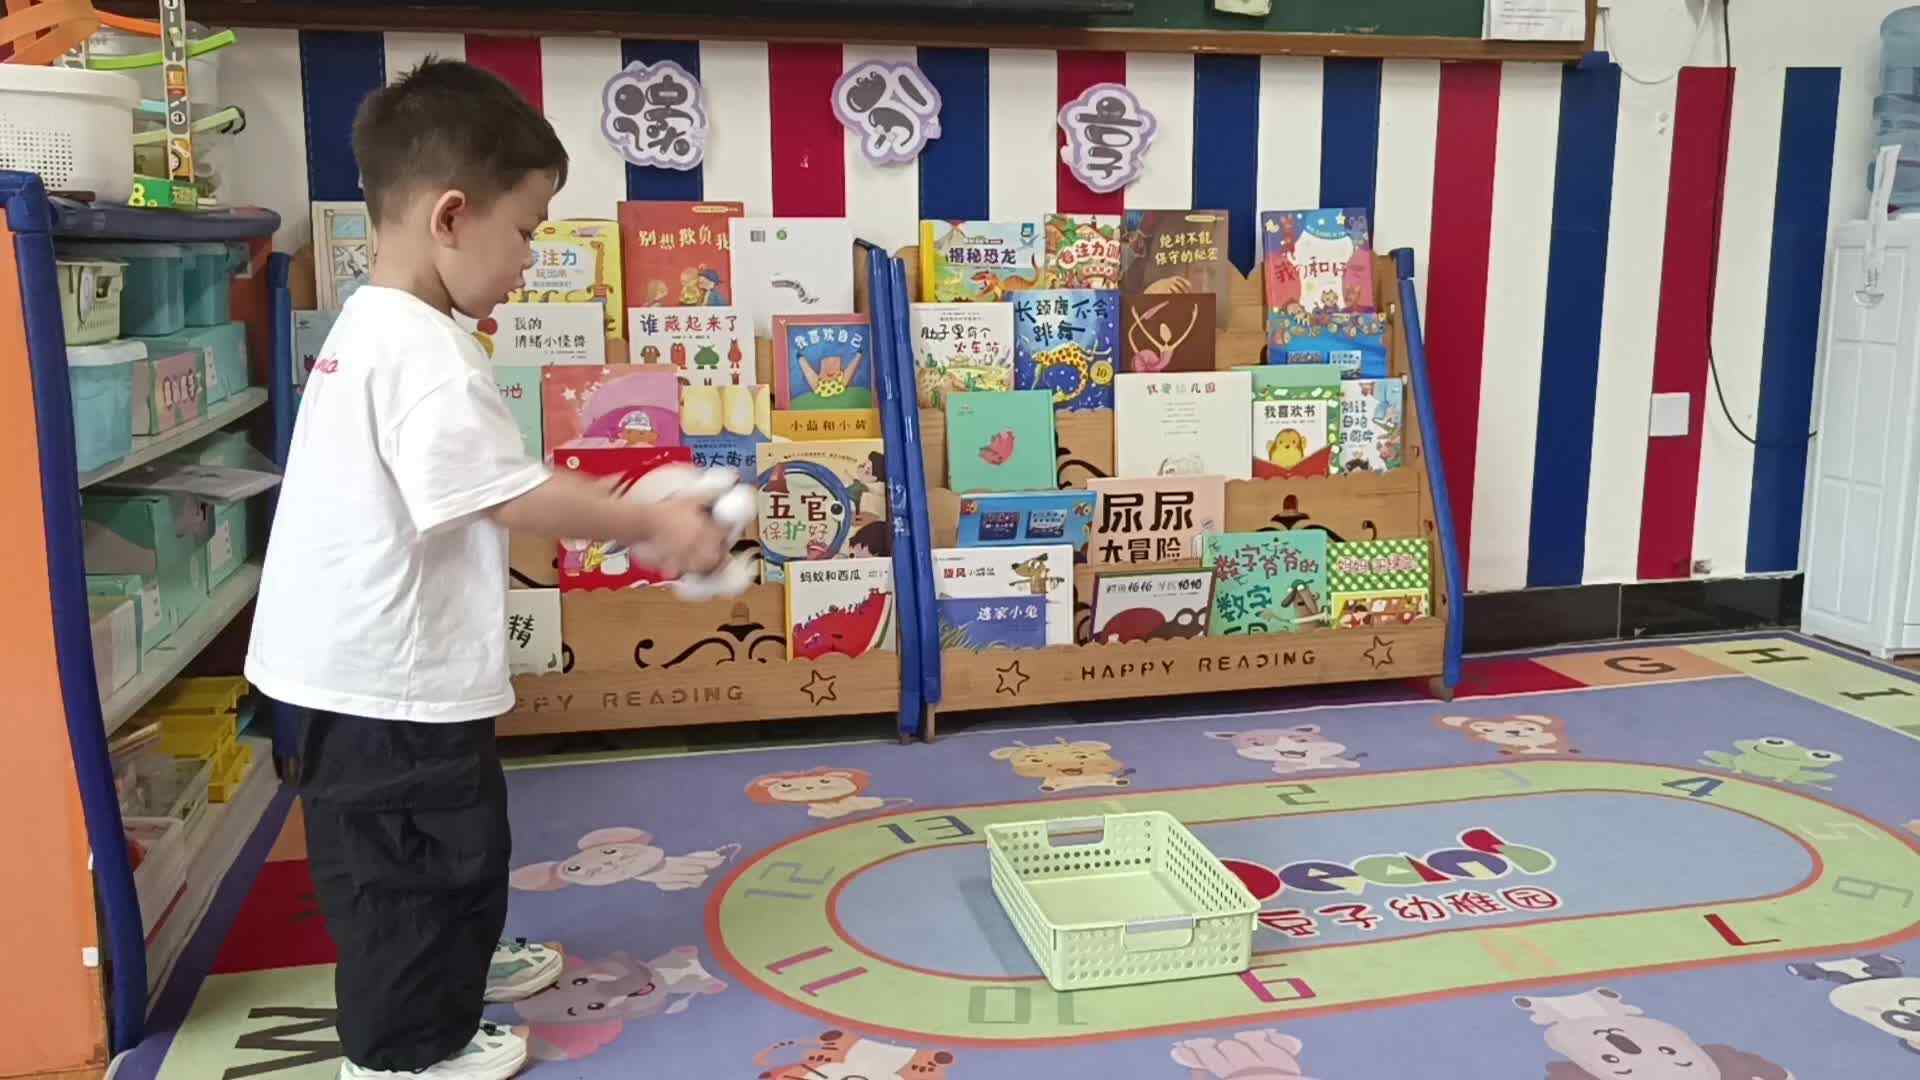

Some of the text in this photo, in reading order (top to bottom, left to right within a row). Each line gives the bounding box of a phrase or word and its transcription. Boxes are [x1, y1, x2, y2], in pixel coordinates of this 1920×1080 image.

[1160, 231, 1213, 248] 绝对不能
[949, 247, 1017, 265] 揭秘恐龙
[1154, 247, 1219, 265] 保守的秘密
[1016, 296, 1109, 324] 长颈鹿不会
[514, 316, 543, 331] 我的
[639, 313, 738, 337] 谁藏起来了
[920, 323, 991, 341] 肚子里有个
[1033, 319, 1086, 347] 跳舞
[514, 334, 586, 349] 情绪小怪兽
[794, 327, 864, 349] 我喜欢自己
[953, 341, 1000, 354] 火车站
[1264, 405, 1316, 418] 我喜欢书
[790, 419, 867, 432] 小蓝和小黄
[766, 494, 828, 520] 五官
[1098, 491, 1195, 534] 尿尿
[762, 521, 829, 542] 保护好
[1099, 537, 1181, 563] 大冒险
[799, 567, 862, 583] 蚂蚁和西瓜
[976, 604, 1039, 622] 逃家小兔
[1216, 585, 1273, 623] 数字
[508, 613, 536, 649] 精
[1081, 650, 1317, 681] HAPPY READING
[1604, 656, 1677, 675] G
[602, 685, 744, 709] READING
